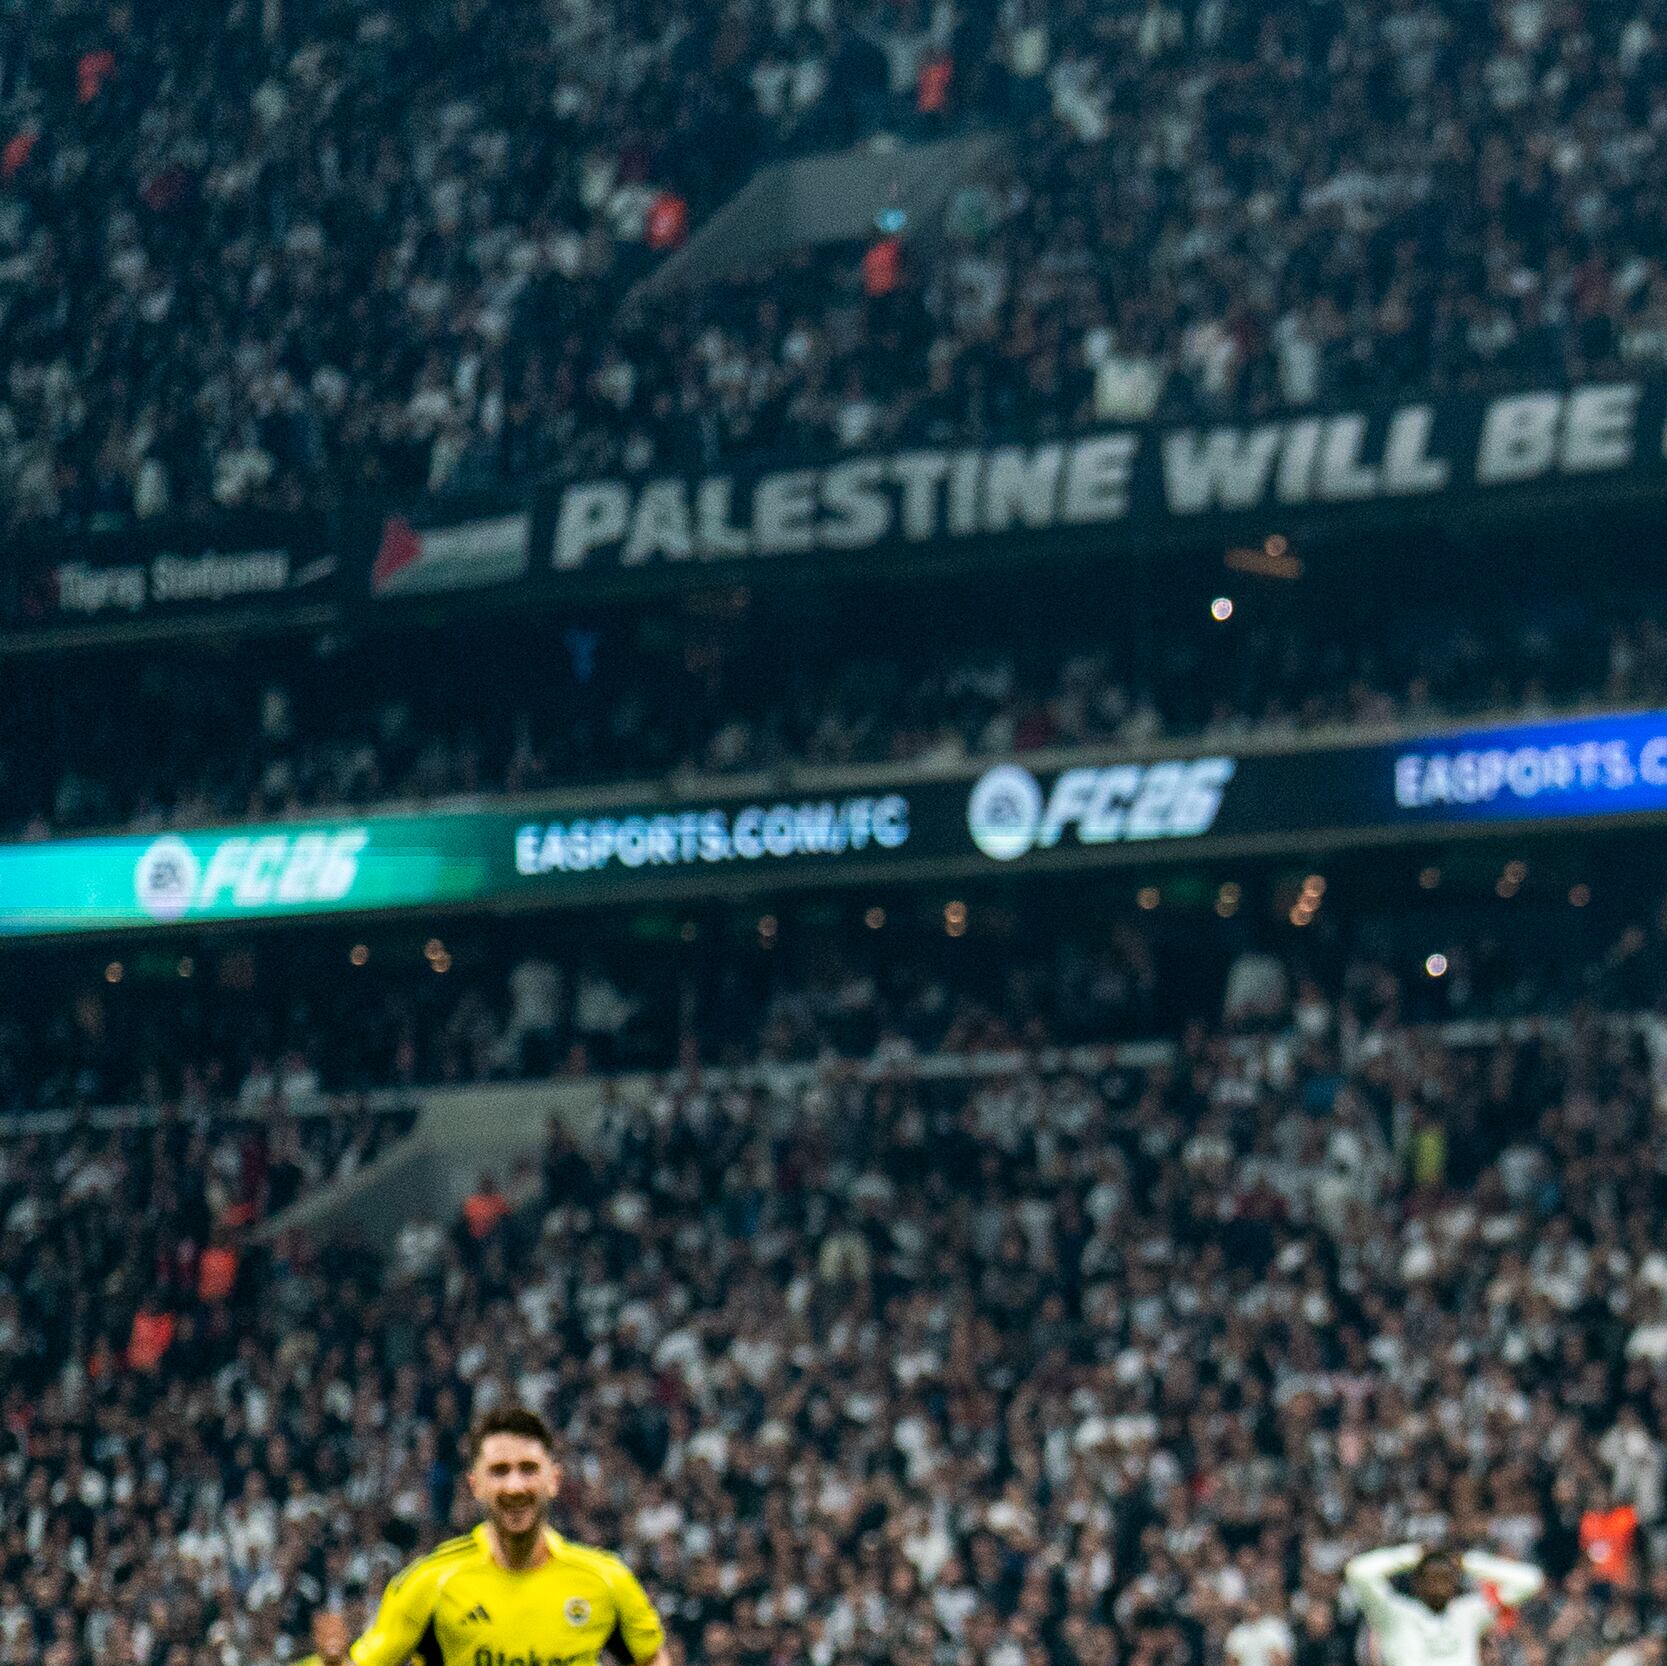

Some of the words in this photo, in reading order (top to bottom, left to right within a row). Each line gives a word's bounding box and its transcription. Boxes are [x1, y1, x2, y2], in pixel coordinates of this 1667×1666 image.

[552, 436, 1139, 570] PALESTINE
[1161, 404, 1449, 516] WILL
[1475, 383, 1642, 482] BE
[516, 795, 910, 876] EASPORTS.COM/FC
